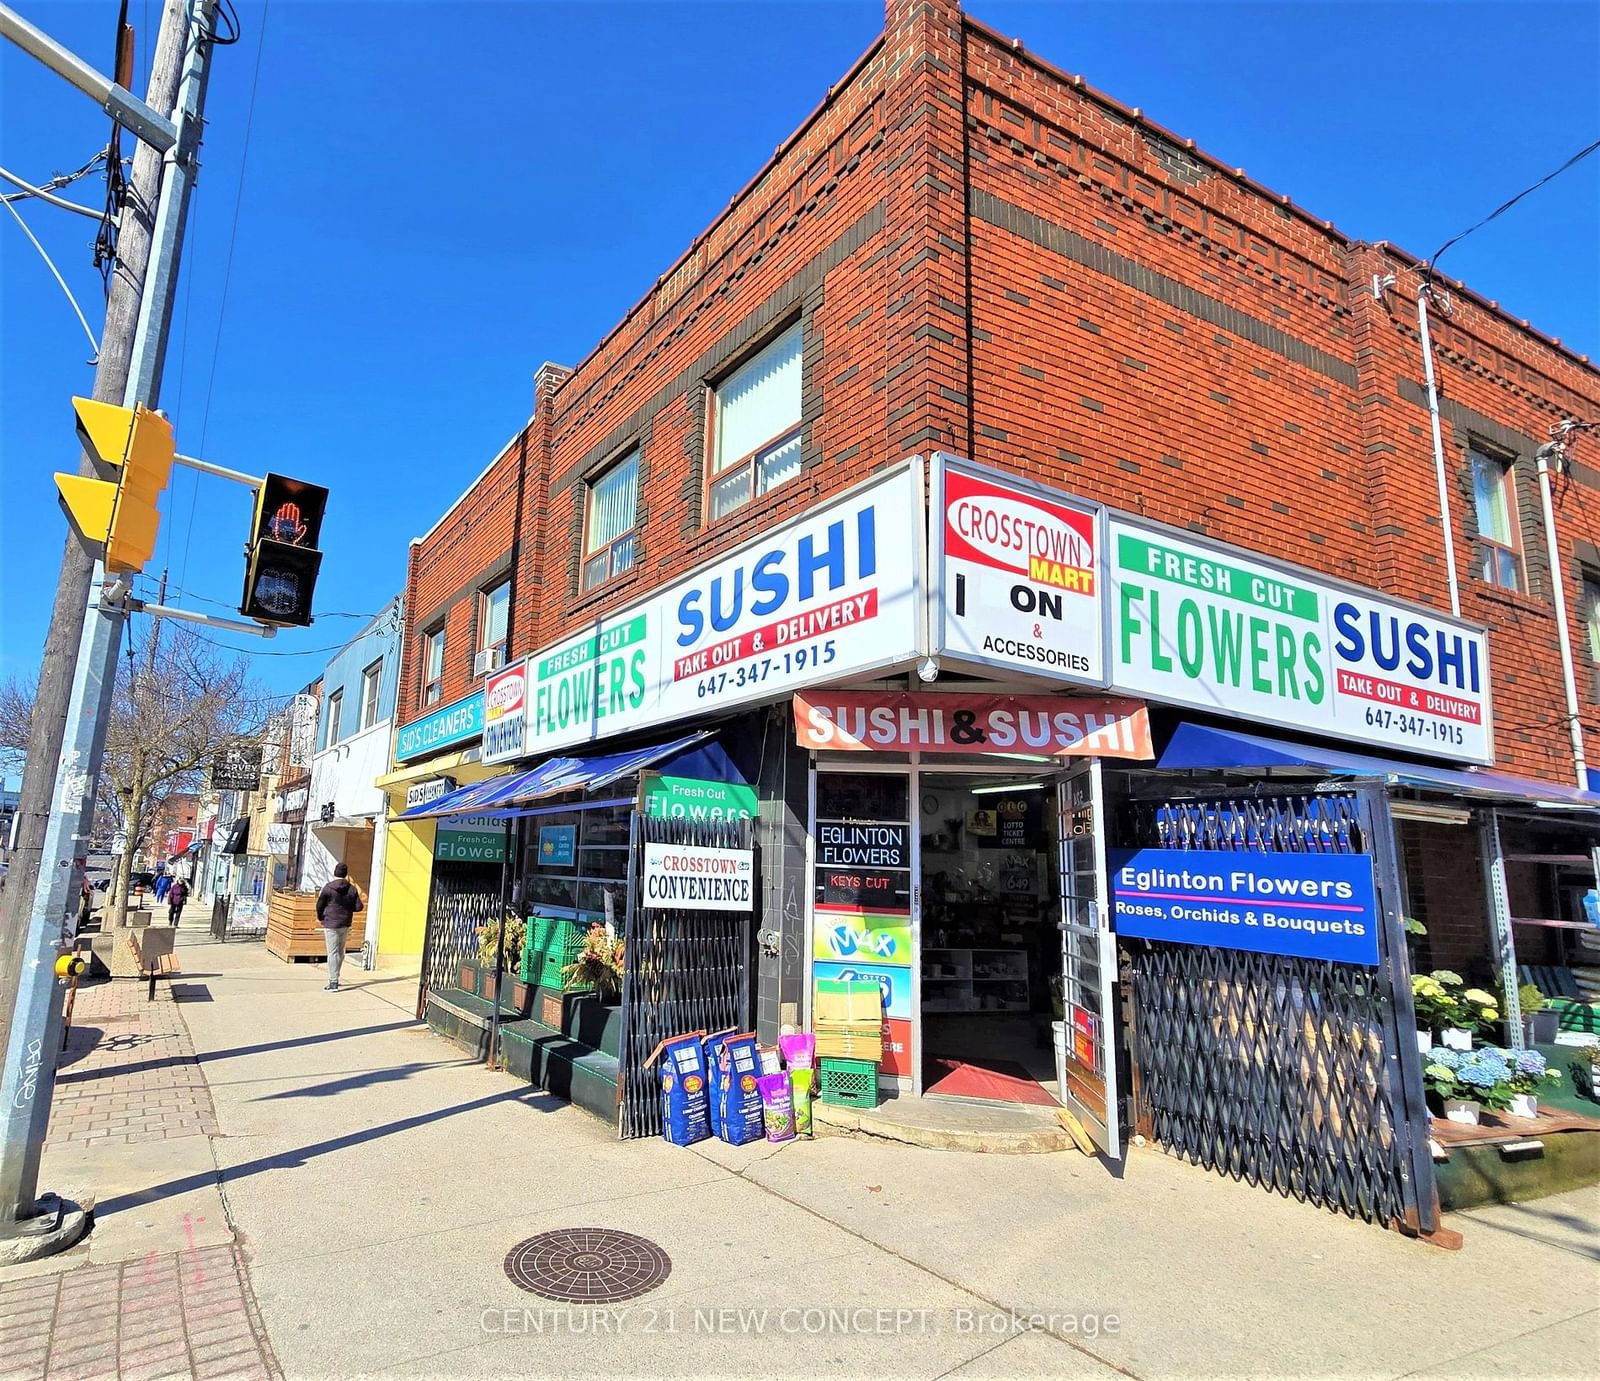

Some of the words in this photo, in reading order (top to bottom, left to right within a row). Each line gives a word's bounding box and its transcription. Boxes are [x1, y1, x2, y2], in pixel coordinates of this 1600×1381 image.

[958, 502, 1082, 568] CROSSTOWN
[677, 505, 876, 647] SUSHI
[1031, 557, 1093, 593] MART
[1147, 547, 1231, 593] FRESH
[1251, 578, 1295, 611] CUT
[1010, 585, 1063, 620] ON
[678, 653, 708, 678] TAKE
[712, 639, 742, 665] OUT
[752, 632, 764, 651] &
[776, 594, 870, 645] DELIVERY
[1033, 623, 1043, 639] &
[1120, 582, 1325, 705] FLOWERS
[547, 642, 590, 676] FRESH
[600, 624, 632, 653] CUT
[983, 635, 1090, 672] ACCESSORIES
[1334, 602, 1480, 694] SUSHI
[697, 639, 836, 698] 647-347-1915
[536, 649, 646, 737] FLOWERS
[1341, 674, 1373, 696] TAKE
[1376, 683, 1402, 702] OUT
[1410, 692, 1419, 706] &
[1427, 695, 1477, 720] DELIVERY
[402, 727, 421, 753] SID'S
[423, 704, 474, 745] CLEANERS
[1365, 707, 1463, 745] 647-347-1915
[645, 795, 751, 820] Flowers
[672, 784, 704, 796] Fresh
[706, 788, 726, 801] Cut
[458, 835, 480, 843] Fresh
[821, 827, 902, 846] EGLINTON
[1003, 829, 1025, 837] TICKET
[1004, 821, 1024, 830] LOTTO
[663, 855, 737, 875] CROSSTOWN
[824, 847, 901, 865] FLOWERS
[648, 875, 749, 902] CONVENIENCE
[830, 875, 861, 888] KEYS
[866, 876, 890, 889] CUT
[1007, 875, 1030, 891] 649
[1121, 867, 1224, 891] Eglinton
[1231, 872, 1354, 899] Flowers
[1115, 902, 1168, 920] Roses,
[1170, 905, 1241, 924] Orchids
[1244, 912, 1259, 927] &
[1262, 913, 1366, 935] Bouquets
[857, 974, 887, 982] LOTTO
[884, 1041, 904, 1053] ERE
